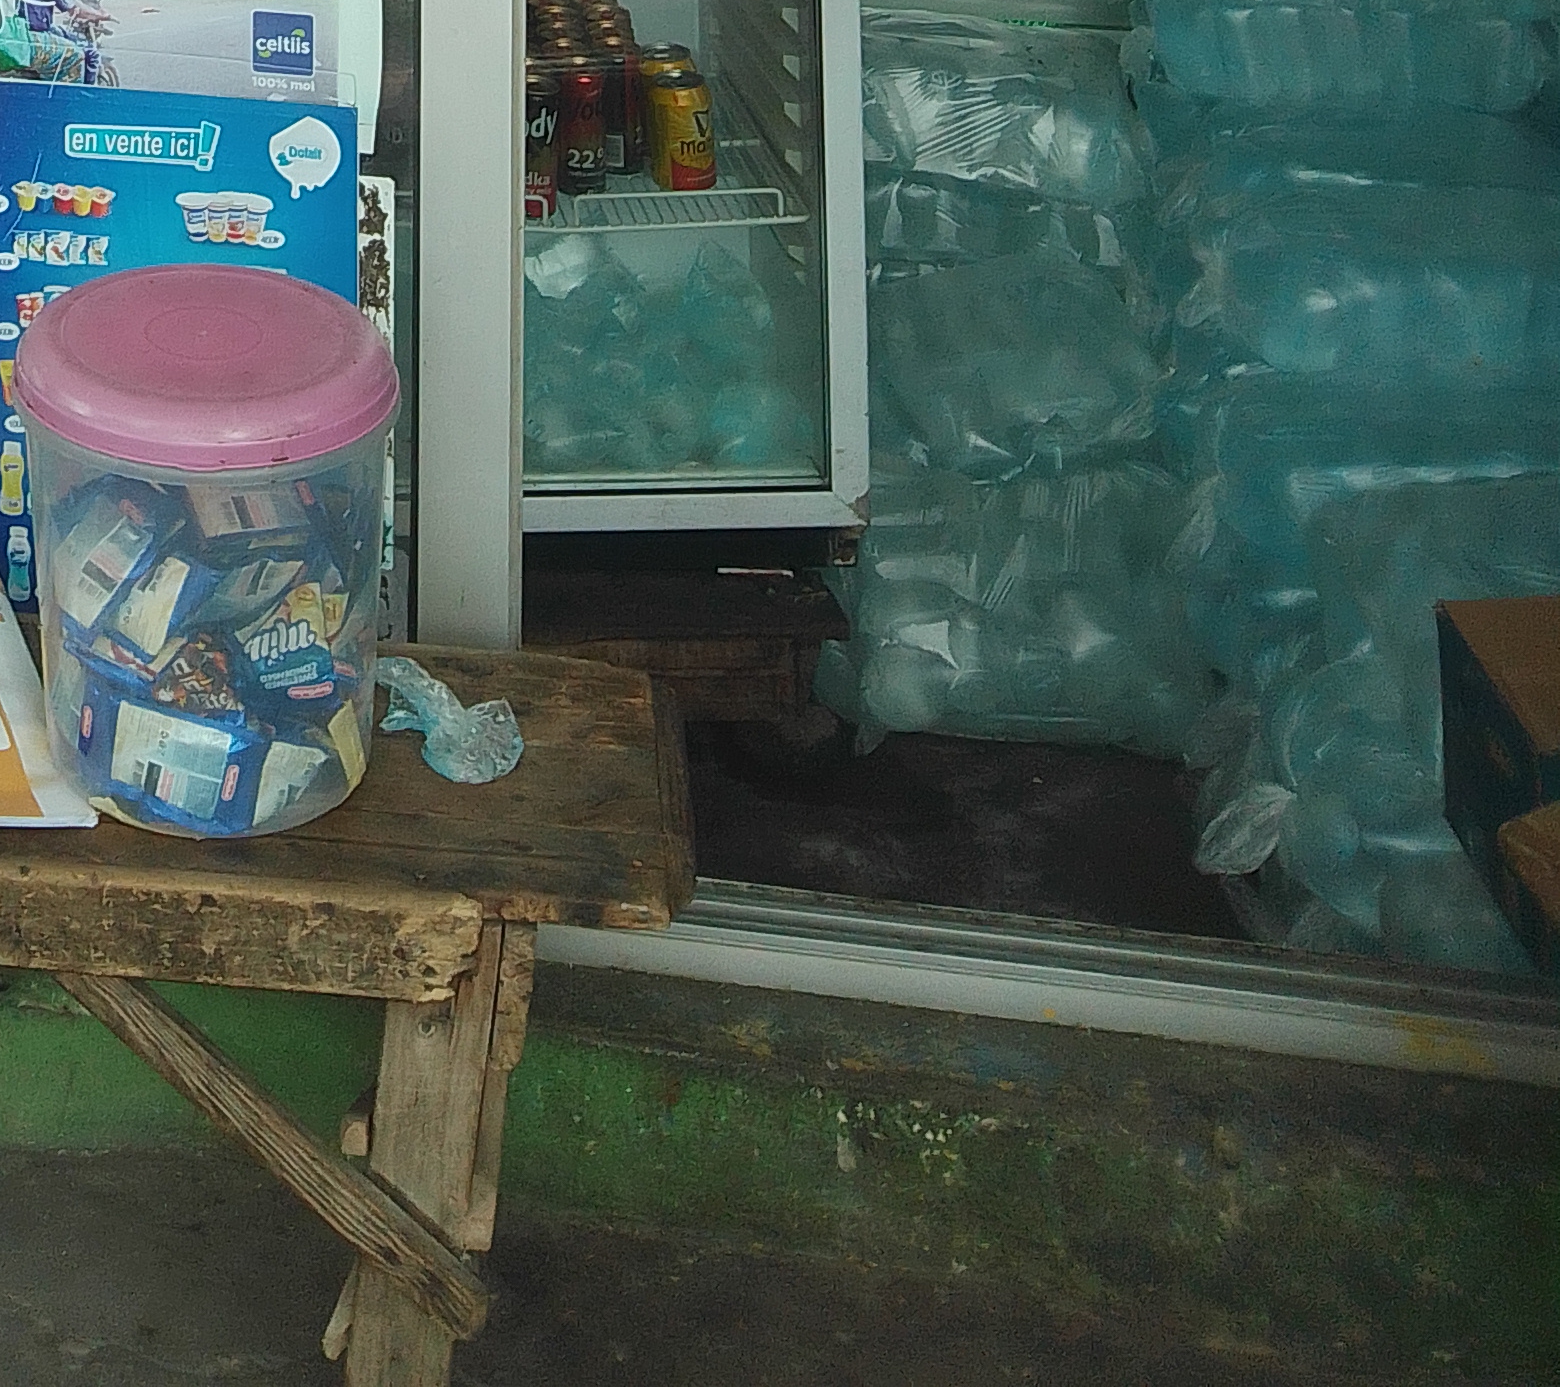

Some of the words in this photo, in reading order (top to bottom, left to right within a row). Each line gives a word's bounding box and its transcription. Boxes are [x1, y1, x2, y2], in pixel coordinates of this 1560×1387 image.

[255, 34, 311, 54] celtiis
[252, 77, 288, 89] 100%
[72, 132, 97, 152] en
[104, 132, 163, 156] vente
[171, 132, 195, 157] ici
